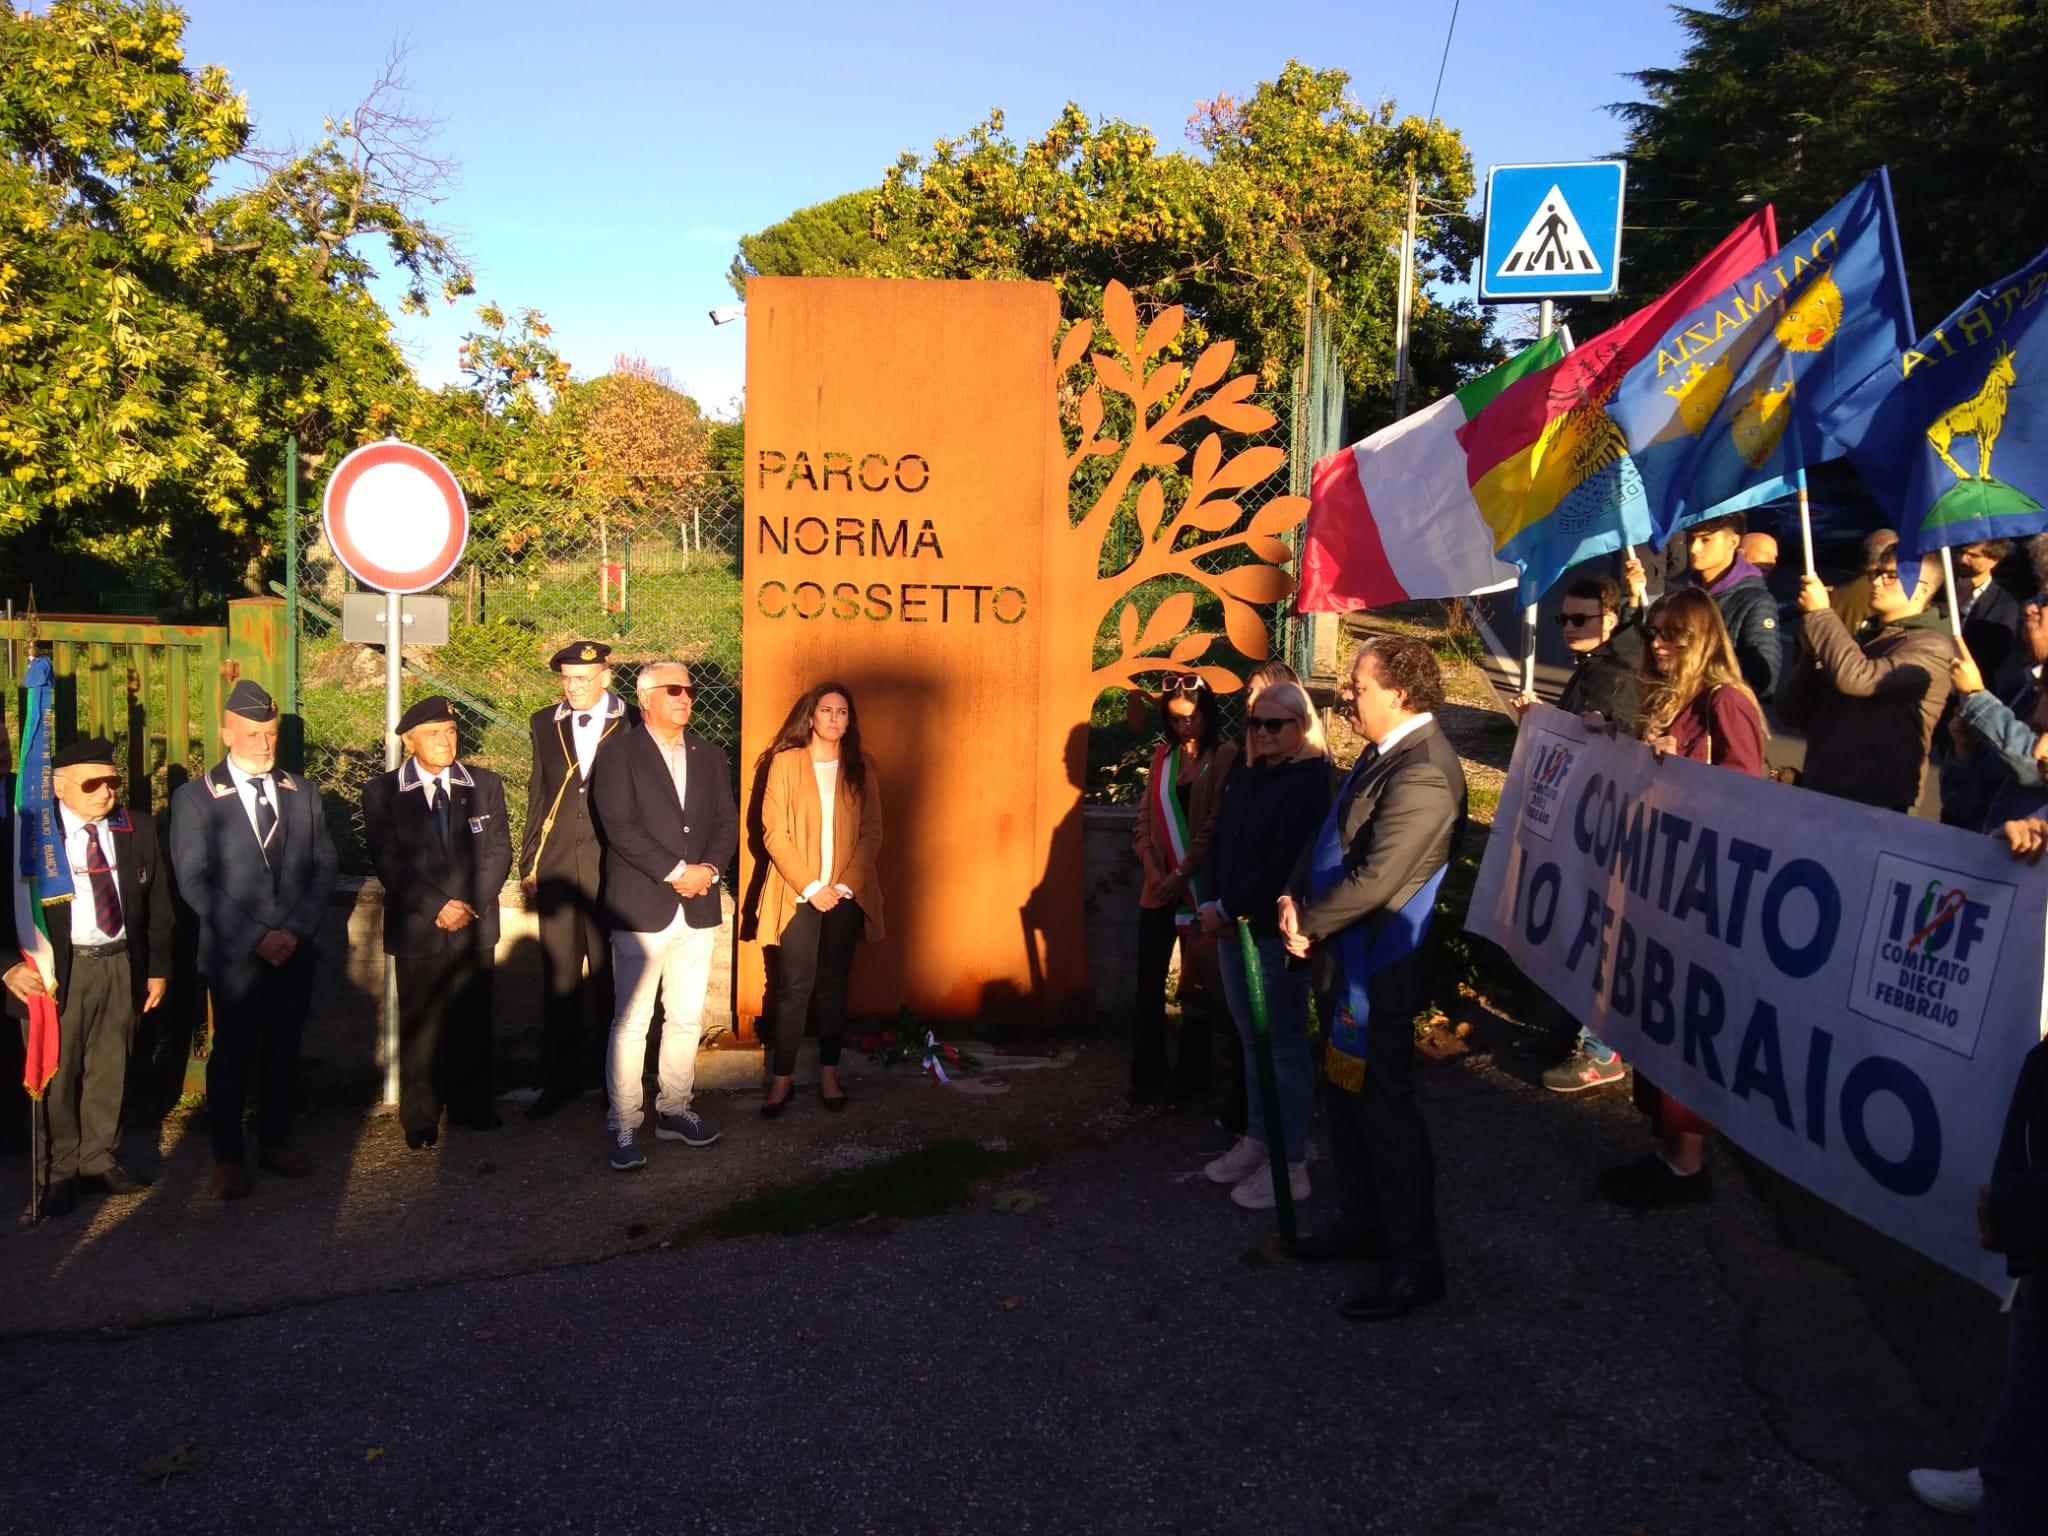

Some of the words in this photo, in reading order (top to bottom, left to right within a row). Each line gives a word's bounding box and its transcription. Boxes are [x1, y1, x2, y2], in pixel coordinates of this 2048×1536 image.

[758, 450, 930, 493] PARCO
[758, 515, 944, 559] NORMA
[757, 580, 1027, 625] COSSETTO
[43, 844, 58, 878] BIANCHI
[1572, 772, 1842, 979] COMITATO
[1881, 943, 1970, 986] COMITATO
[1898, 969, 1946, 1000] DIECI
[1875, 982, 1959, 1028] FEBBRAIO
[1566, 888, 1942, 1197] FEBBRAIO
